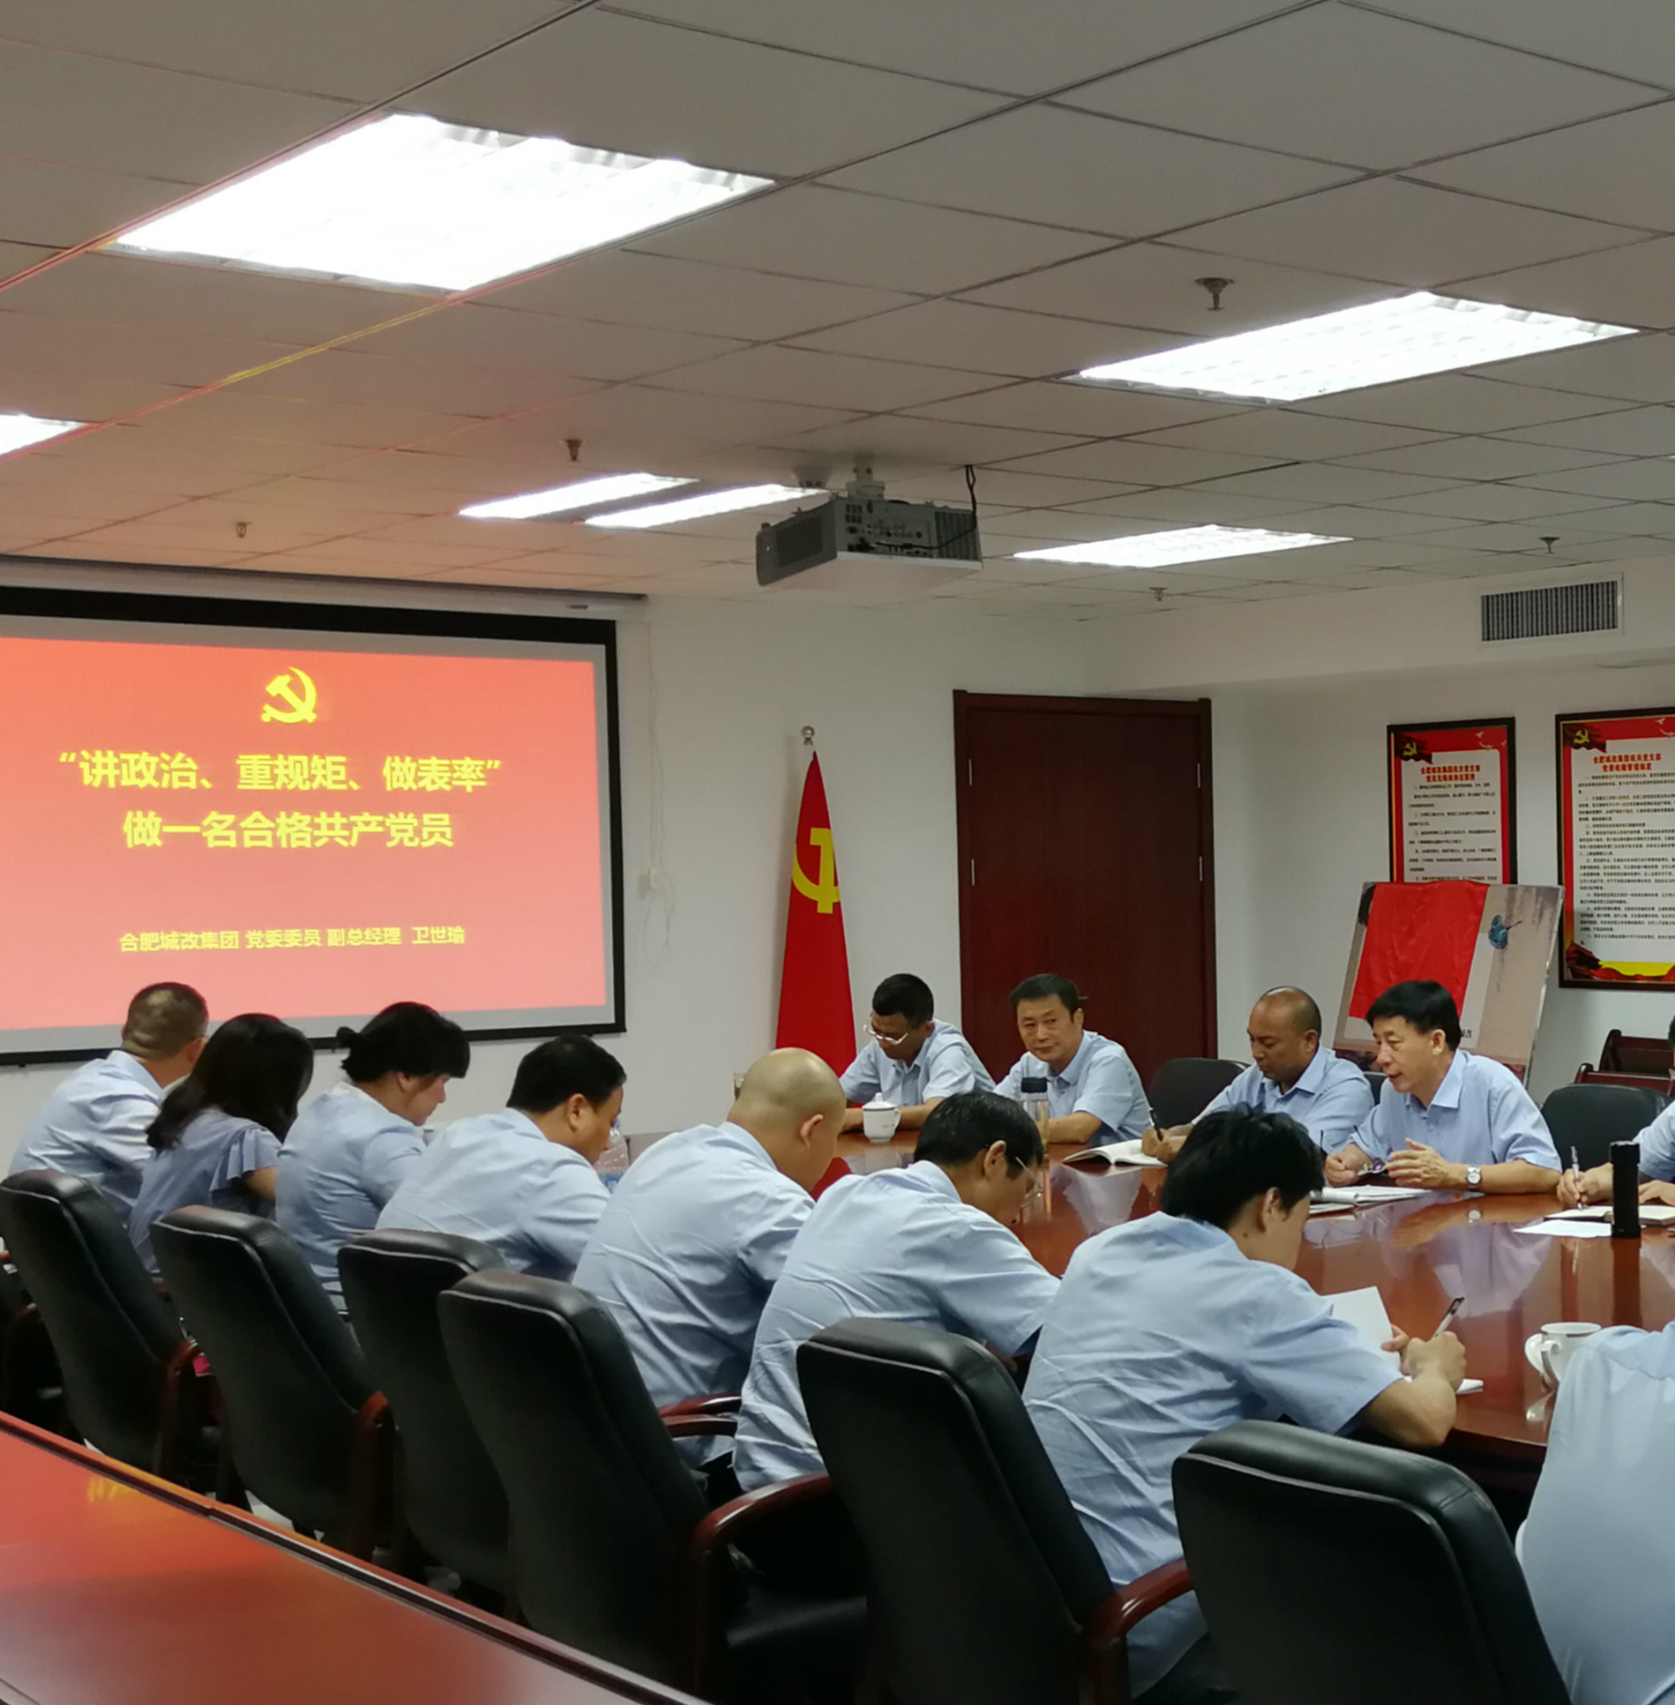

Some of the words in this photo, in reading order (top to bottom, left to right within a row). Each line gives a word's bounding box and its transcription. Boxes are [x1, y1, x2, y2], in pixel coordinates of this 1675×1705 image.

[121, 809, 455, 850] 做一名合格共产党员
[119, 931, 240, 952] 合肥城改集团
[245, 929, 322, 949] 党委委员
[326, 927, 402, 947] 副总经理
